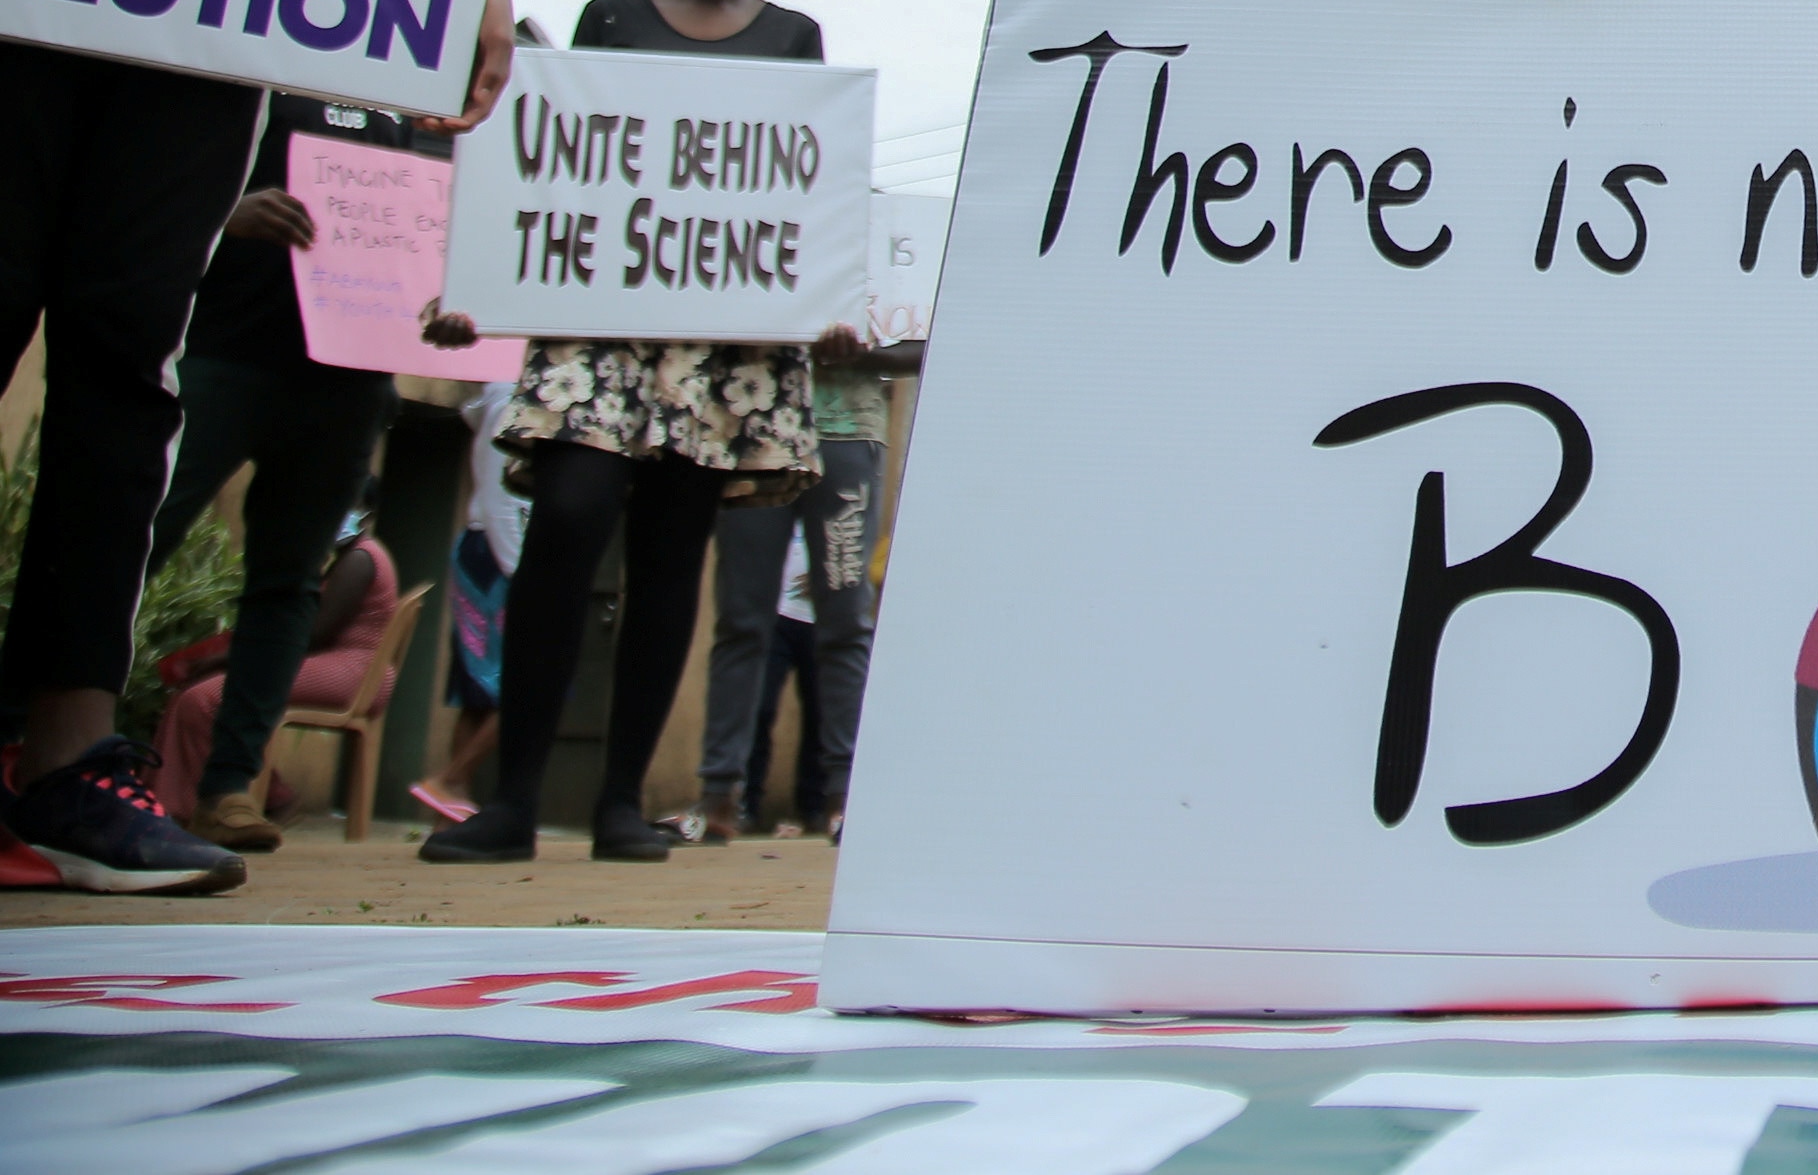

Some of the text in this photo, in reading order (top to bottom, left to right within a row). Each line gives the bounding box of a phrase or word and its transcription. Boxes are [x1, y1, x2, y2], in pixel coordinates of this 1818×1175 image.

[313, 156, 413, 188] IMAGINE
[514, 93, 821, 196] UNITE BEHIND
[1028, 31, 1453, 278] There
[1534, 96, 1669, 275] is
[328, 196, 397, 226] PEOPLE
[514, 197, 800, 292] THE SCIENCE
[1311, 382, 1681, 849] B
